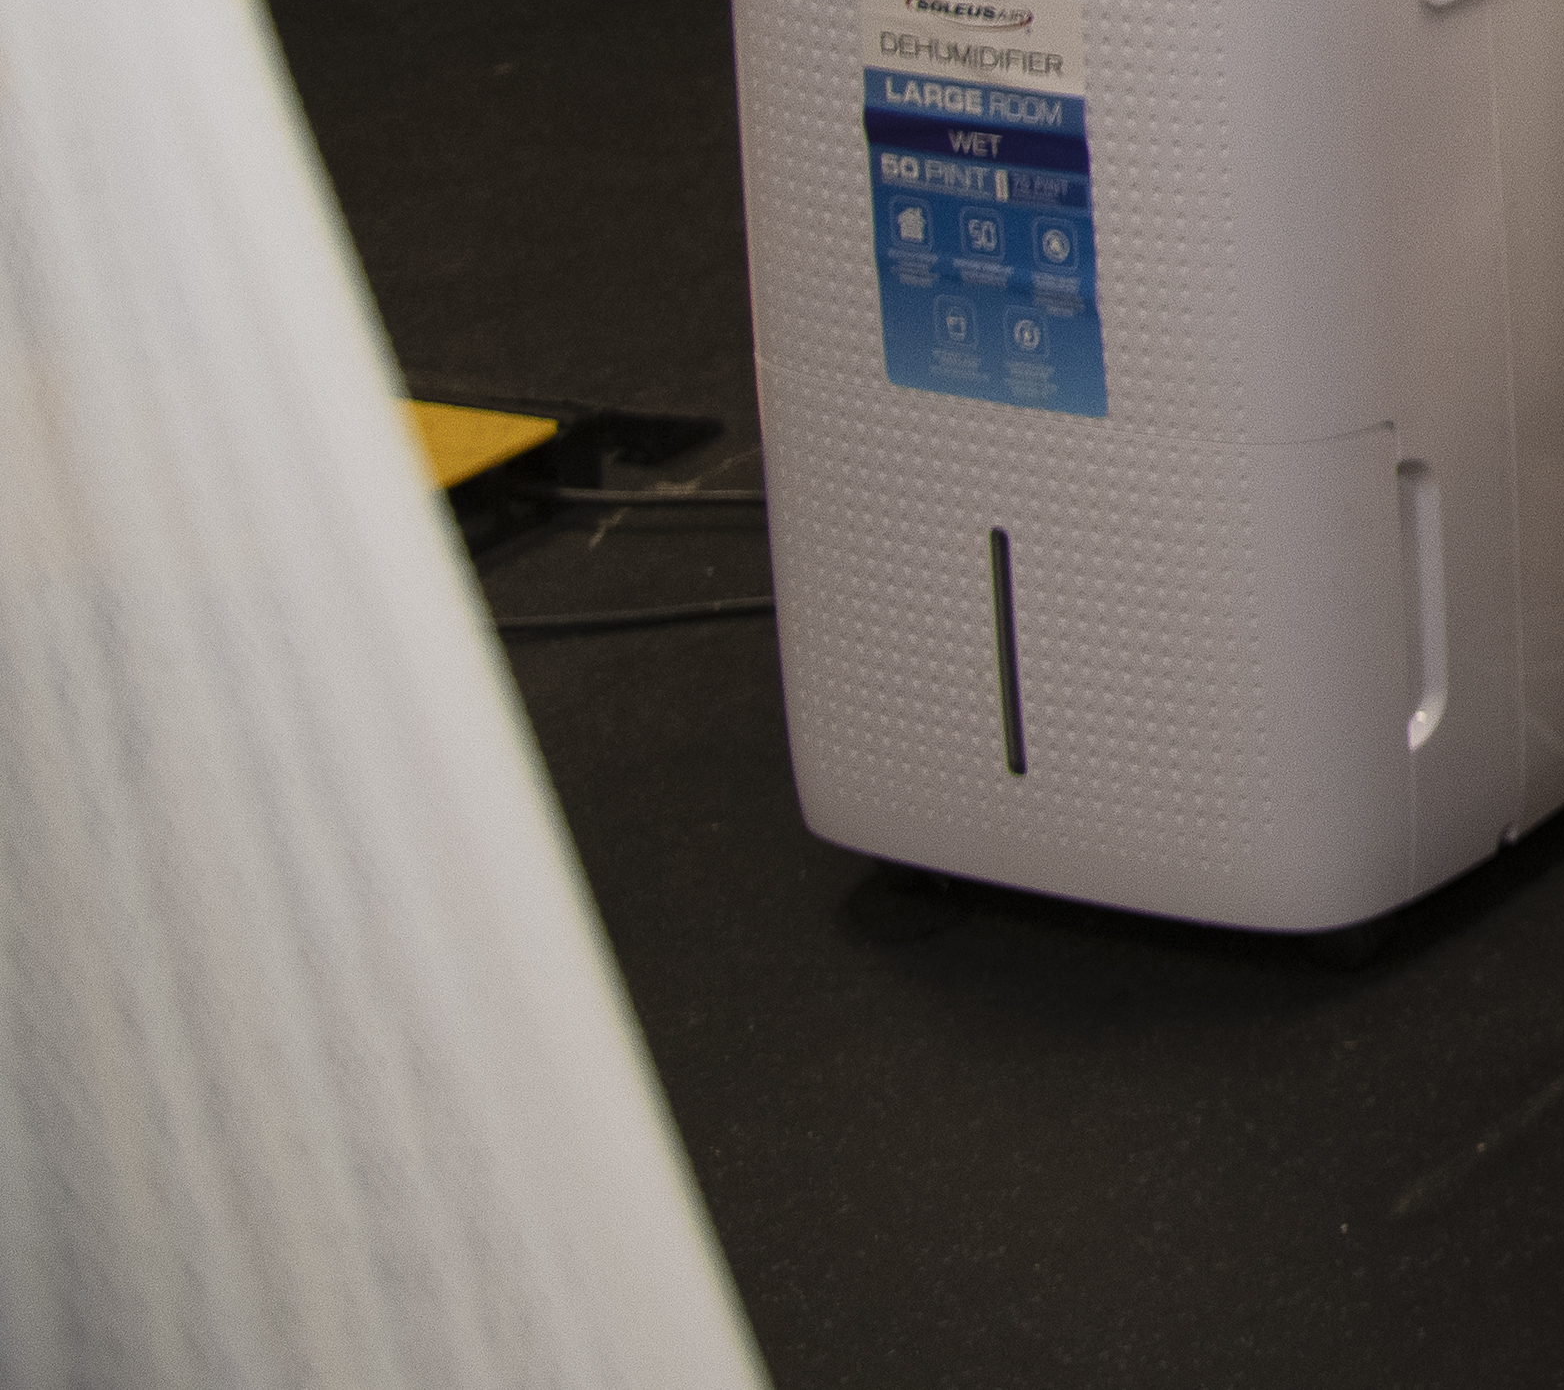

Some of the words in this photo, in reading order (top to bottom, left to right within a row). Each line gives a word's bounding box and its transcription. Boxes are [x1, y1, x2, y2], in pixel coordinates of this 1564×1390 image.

[880, 30, 1064, 77] DEHUMIDIFIER
[885, 77, 983, 116] LARGE
[989, 91, 1063, 127] ROOM
[948, 129, 1002, 158] WET
[924, 159, 989, 190] PINT
